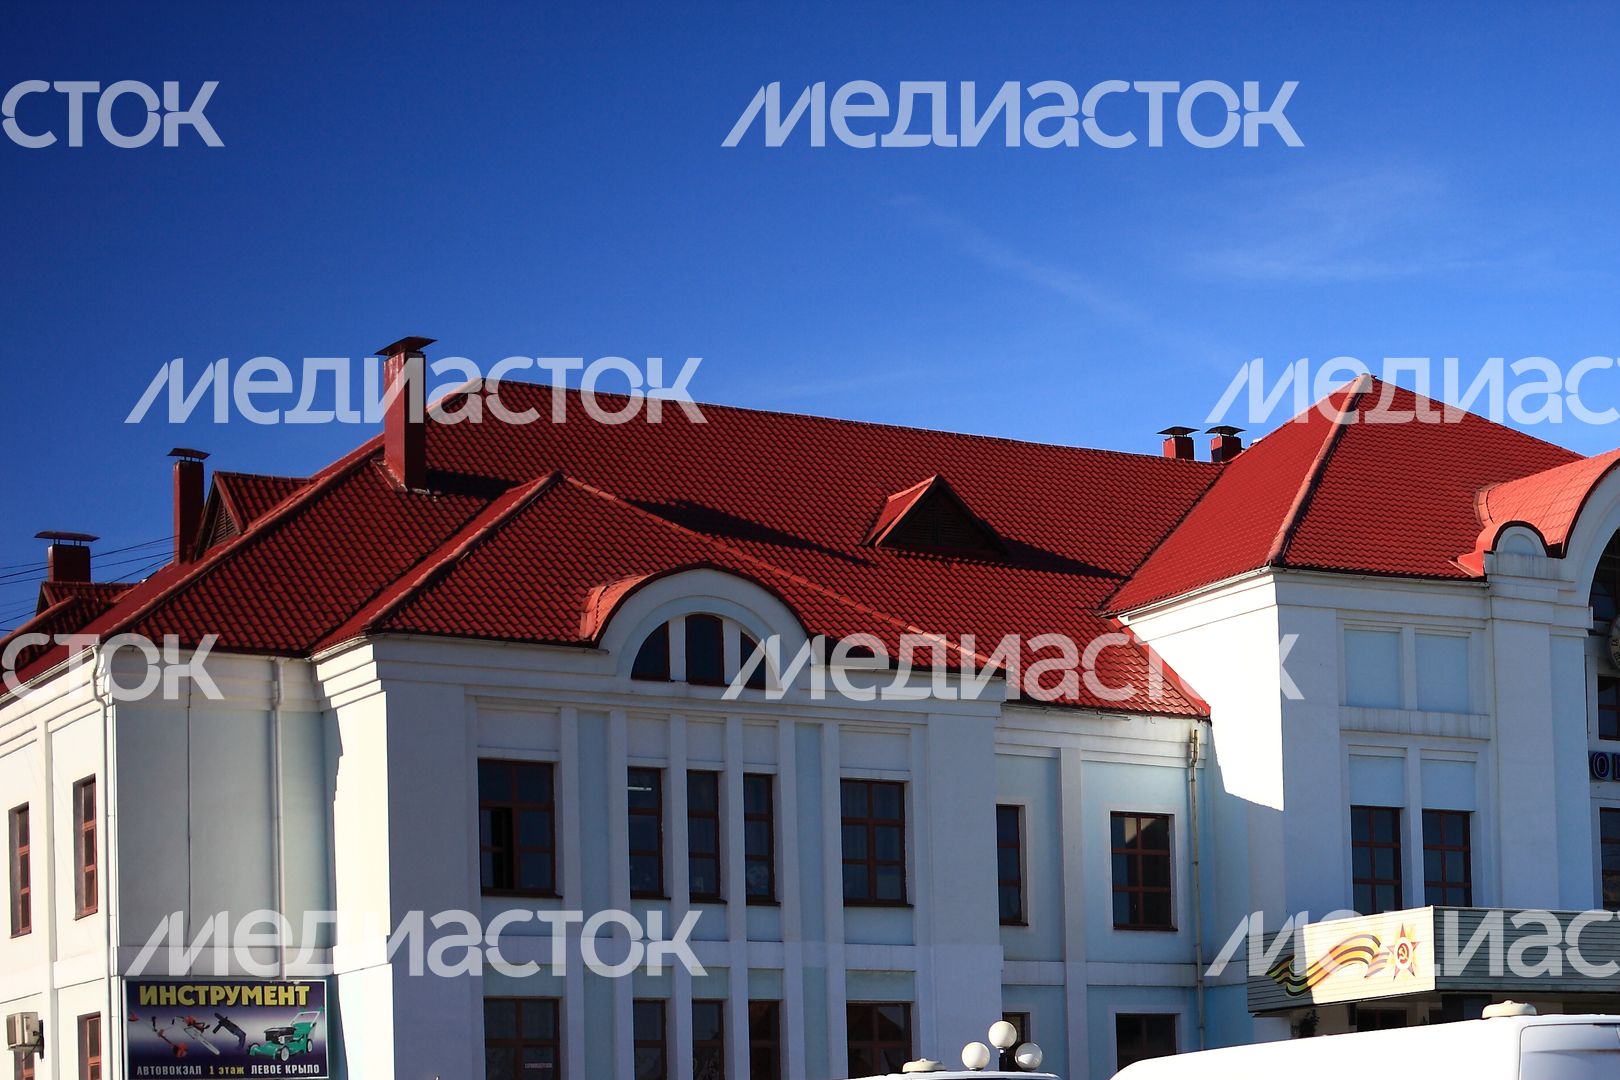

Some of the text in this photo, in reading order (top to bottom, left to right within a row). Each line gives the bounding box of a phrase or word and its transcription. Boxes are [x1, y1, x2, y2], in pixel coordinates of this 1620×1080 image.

[138, 985, 311, 1007] ИНСТРУМЕНТ
[136, 1064, 320, 1076] АВТОВОКЗАЛ 1 этаж ЛЕВОЕ КРЫЛО
